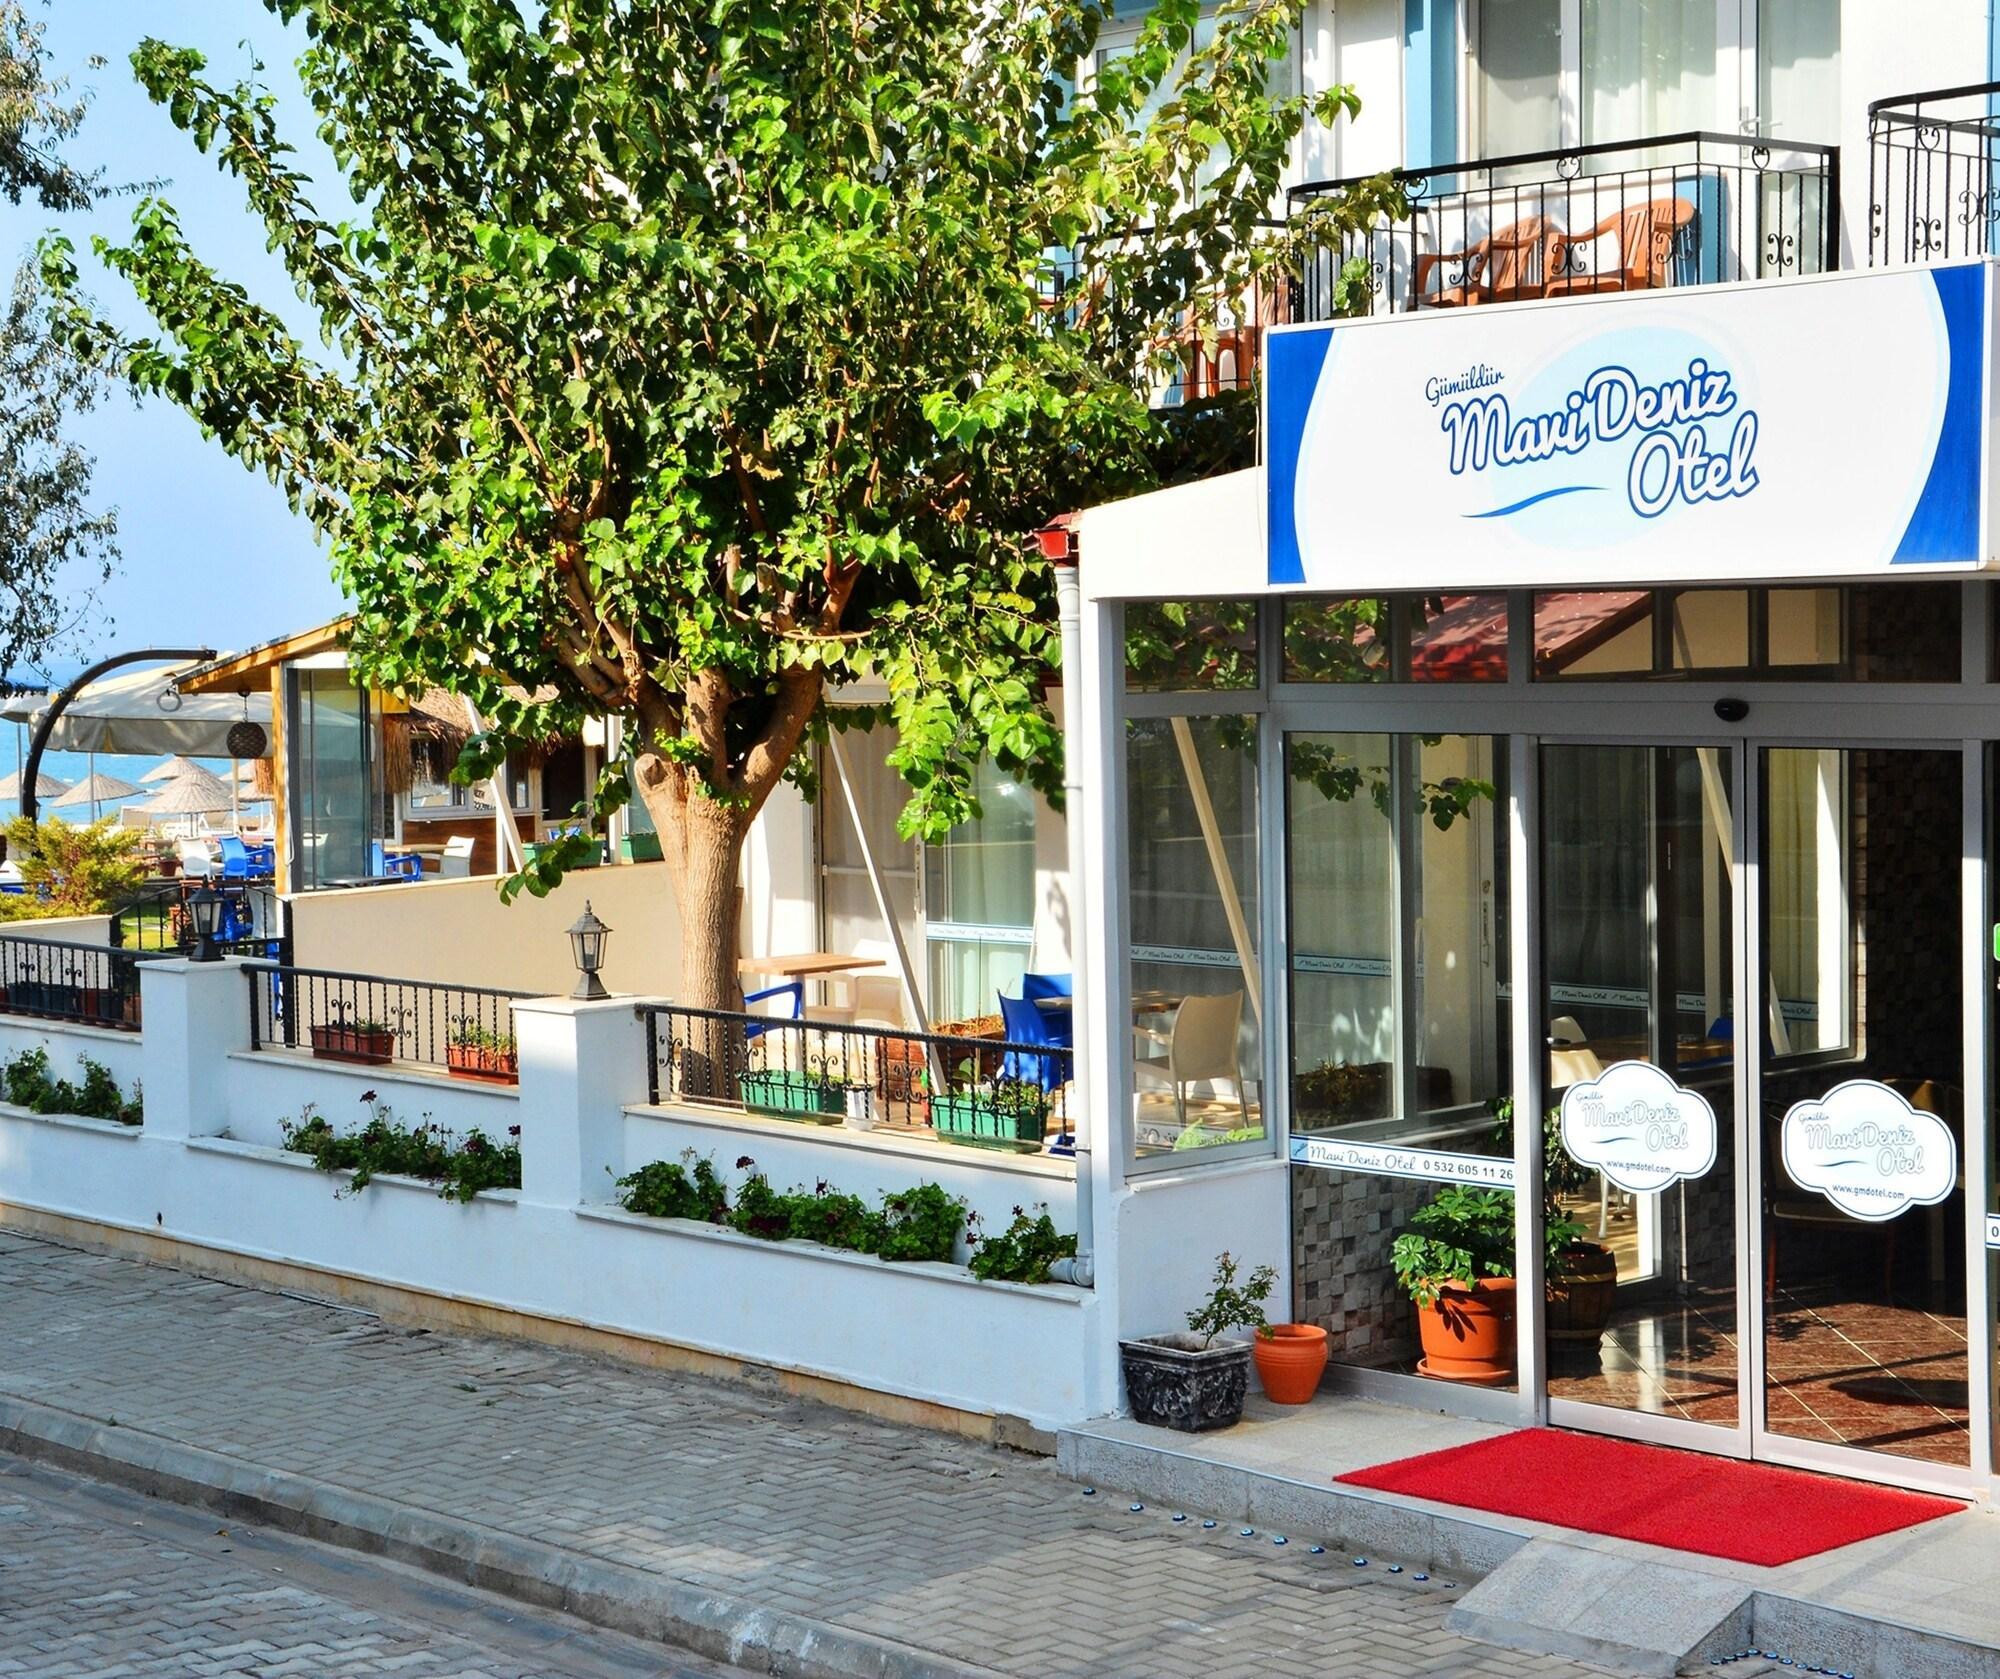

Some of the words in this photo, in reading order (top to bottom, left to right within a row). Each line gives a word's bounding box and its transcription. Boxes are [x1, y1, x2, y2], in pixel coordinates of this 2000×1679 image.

[1441, 391, 1590, 475] Mavi
[1585, 357, 1737, 442] Deniz
[1628, 410, 1760, 518] Otel
[1582, 1102, 1632, 1127] Mavi
[1630, 1100, 1681, 1124] Deniz
[1645, 1122, 1688, 1152] Otel
[1805, 1123, 1862, 1149] Mavi
[1860, 1121, 1916, 1147] Deniz
[1309, 1145, 1345, 1162] Mavi
[1348, 1150, 1381, 1167] Deniz
[1384, 1153, 1416, 1171] Otel
[1423, 1159, 1431, 1170] 0
[1433, 1160, 1454, 1173] 532
[1457, 1164, 1479, 1176] 605
[1483, 1167, 1495, 1178] 11
[1499, 1168, 1514, 1180] 26
[1606, 1160, 1671, 1174] www.gmdotel.com
[1876, 1145, 1925, 1176] Otel
[1833, 1184, 1905, 1200] www.gmdotel.com
